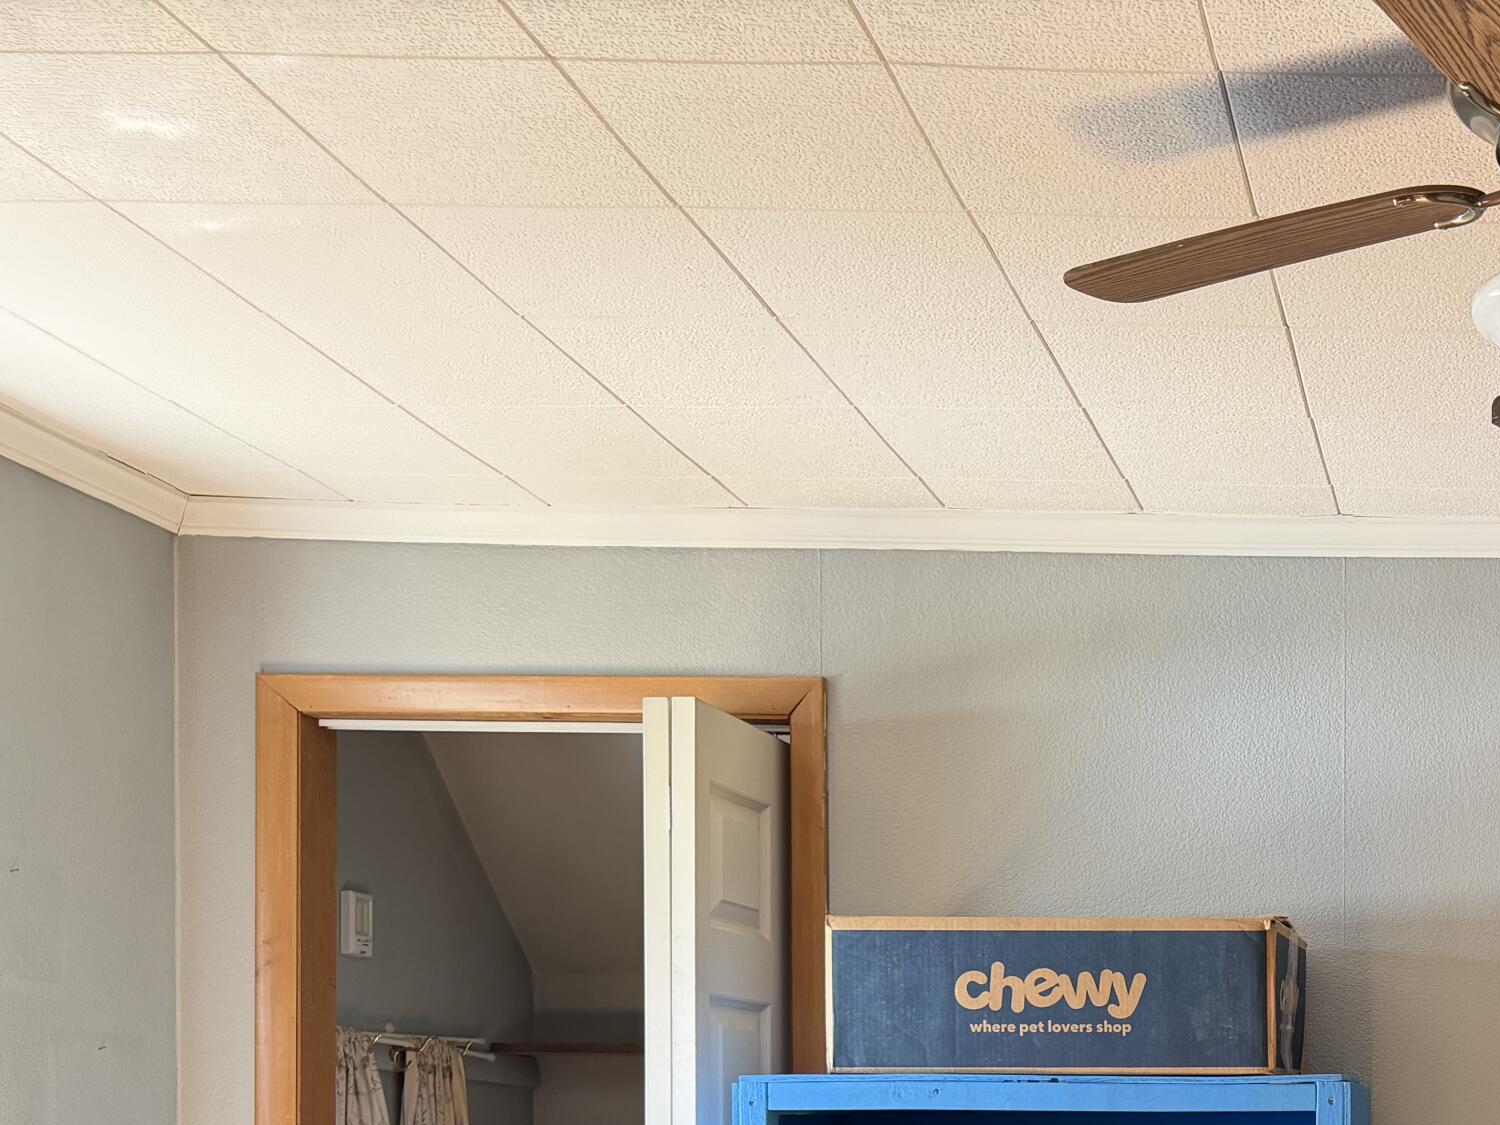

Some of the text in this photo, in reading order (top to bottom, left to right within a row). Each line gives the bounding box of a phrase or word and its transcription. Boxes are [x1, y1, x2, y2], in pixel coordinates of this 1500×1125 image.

[954, 961, 1147, 1020] chewy
[970, 1020, 1132, 1037] where pet lovers shop
